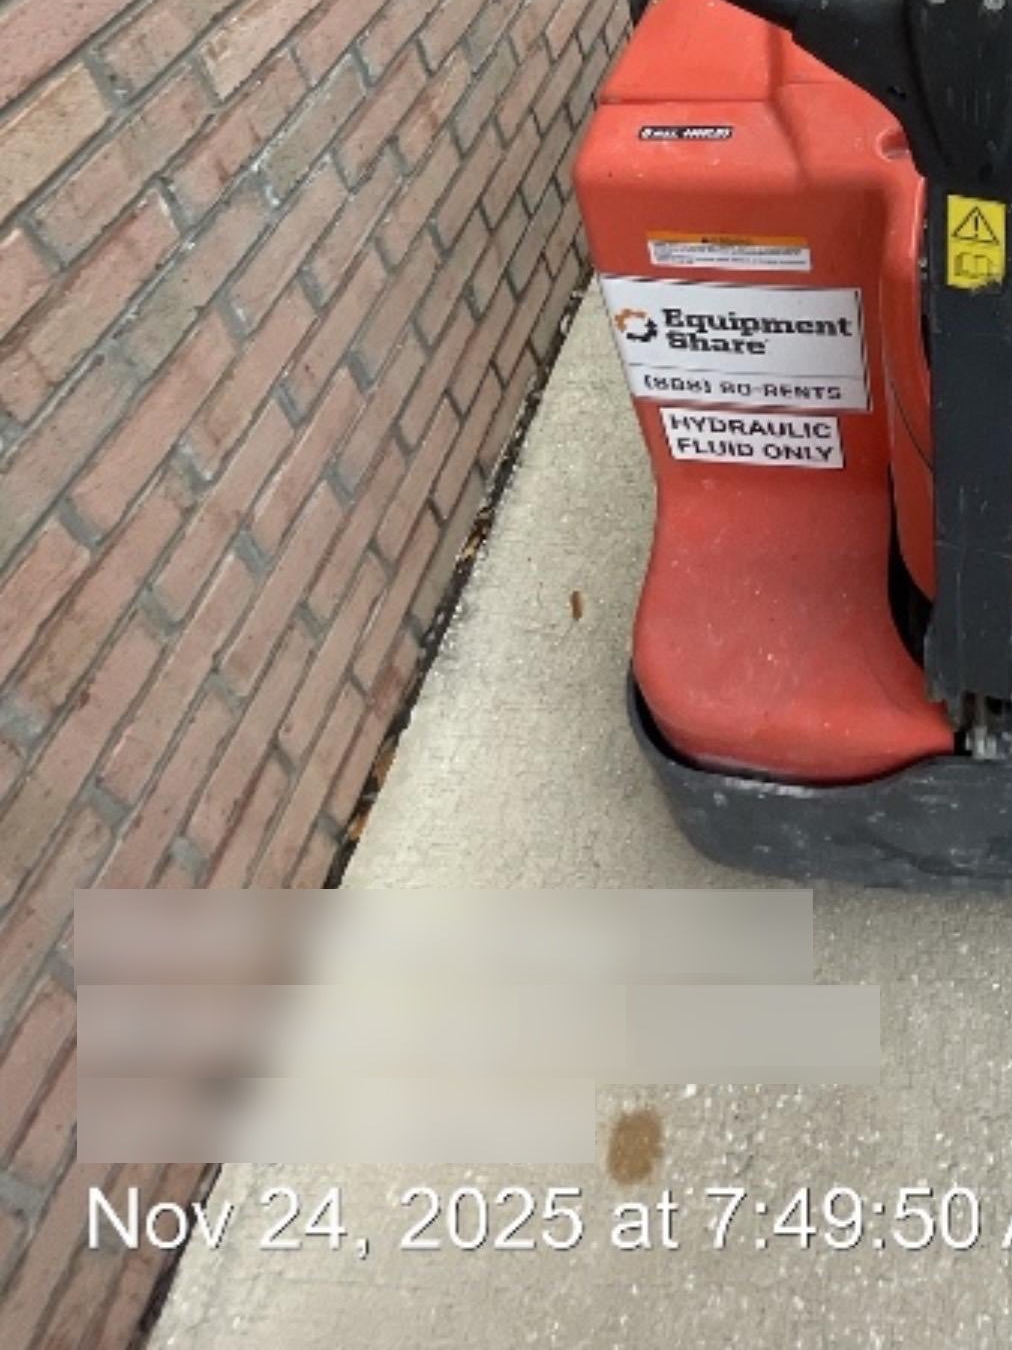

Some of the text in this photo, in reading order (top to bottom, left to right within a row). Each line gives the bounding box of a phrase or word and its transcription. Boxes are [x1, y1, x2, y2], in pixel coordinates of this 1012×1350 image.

[662, 308, 852, 337] Equipment
[666, 332, 767, 355] Share
[671, 414, 832, 439] HYDRAULIC
[677, 437, 834, 462] FLUID ONLY
